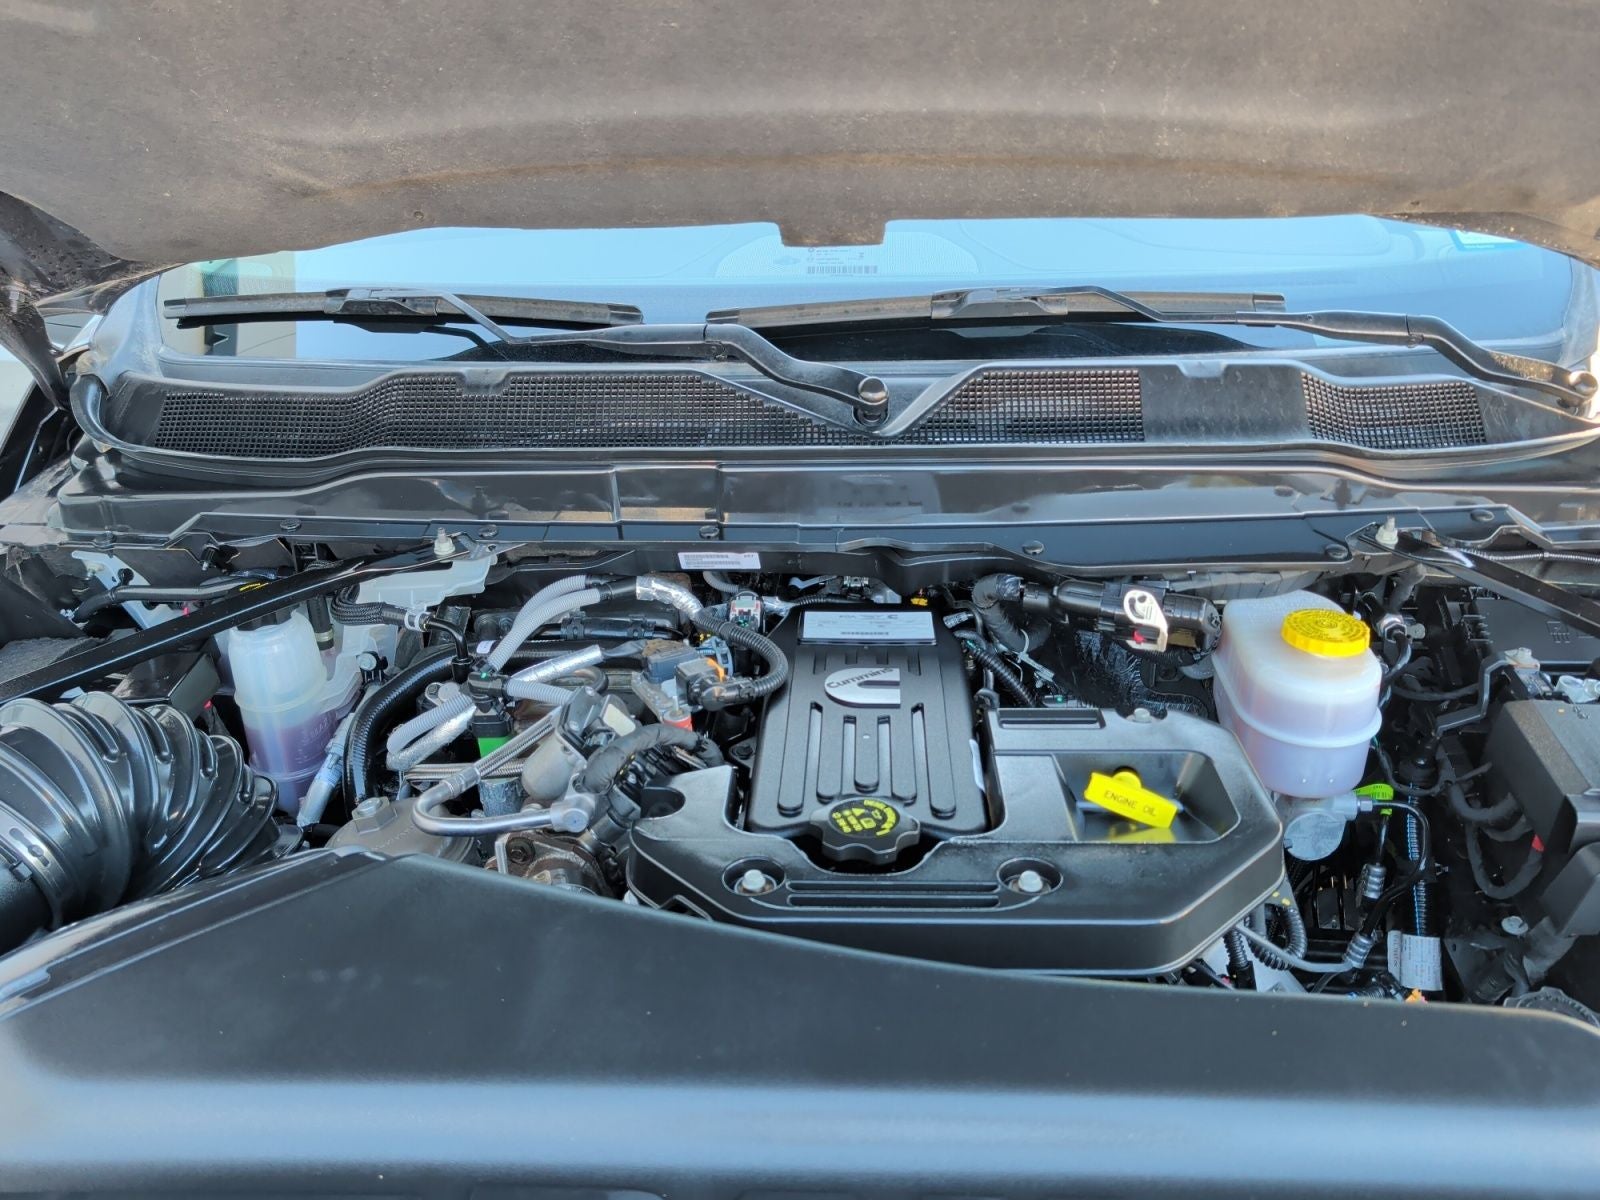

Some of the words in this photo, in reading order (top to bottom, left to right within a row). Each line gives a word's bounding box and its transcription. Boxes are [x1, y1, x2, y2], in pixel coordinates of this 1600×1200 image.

[826, 667, 894, 689] Cummins
[1104, 790, 1138, 809] ENGINE
[1143, 804, 1157, 816] OIL
